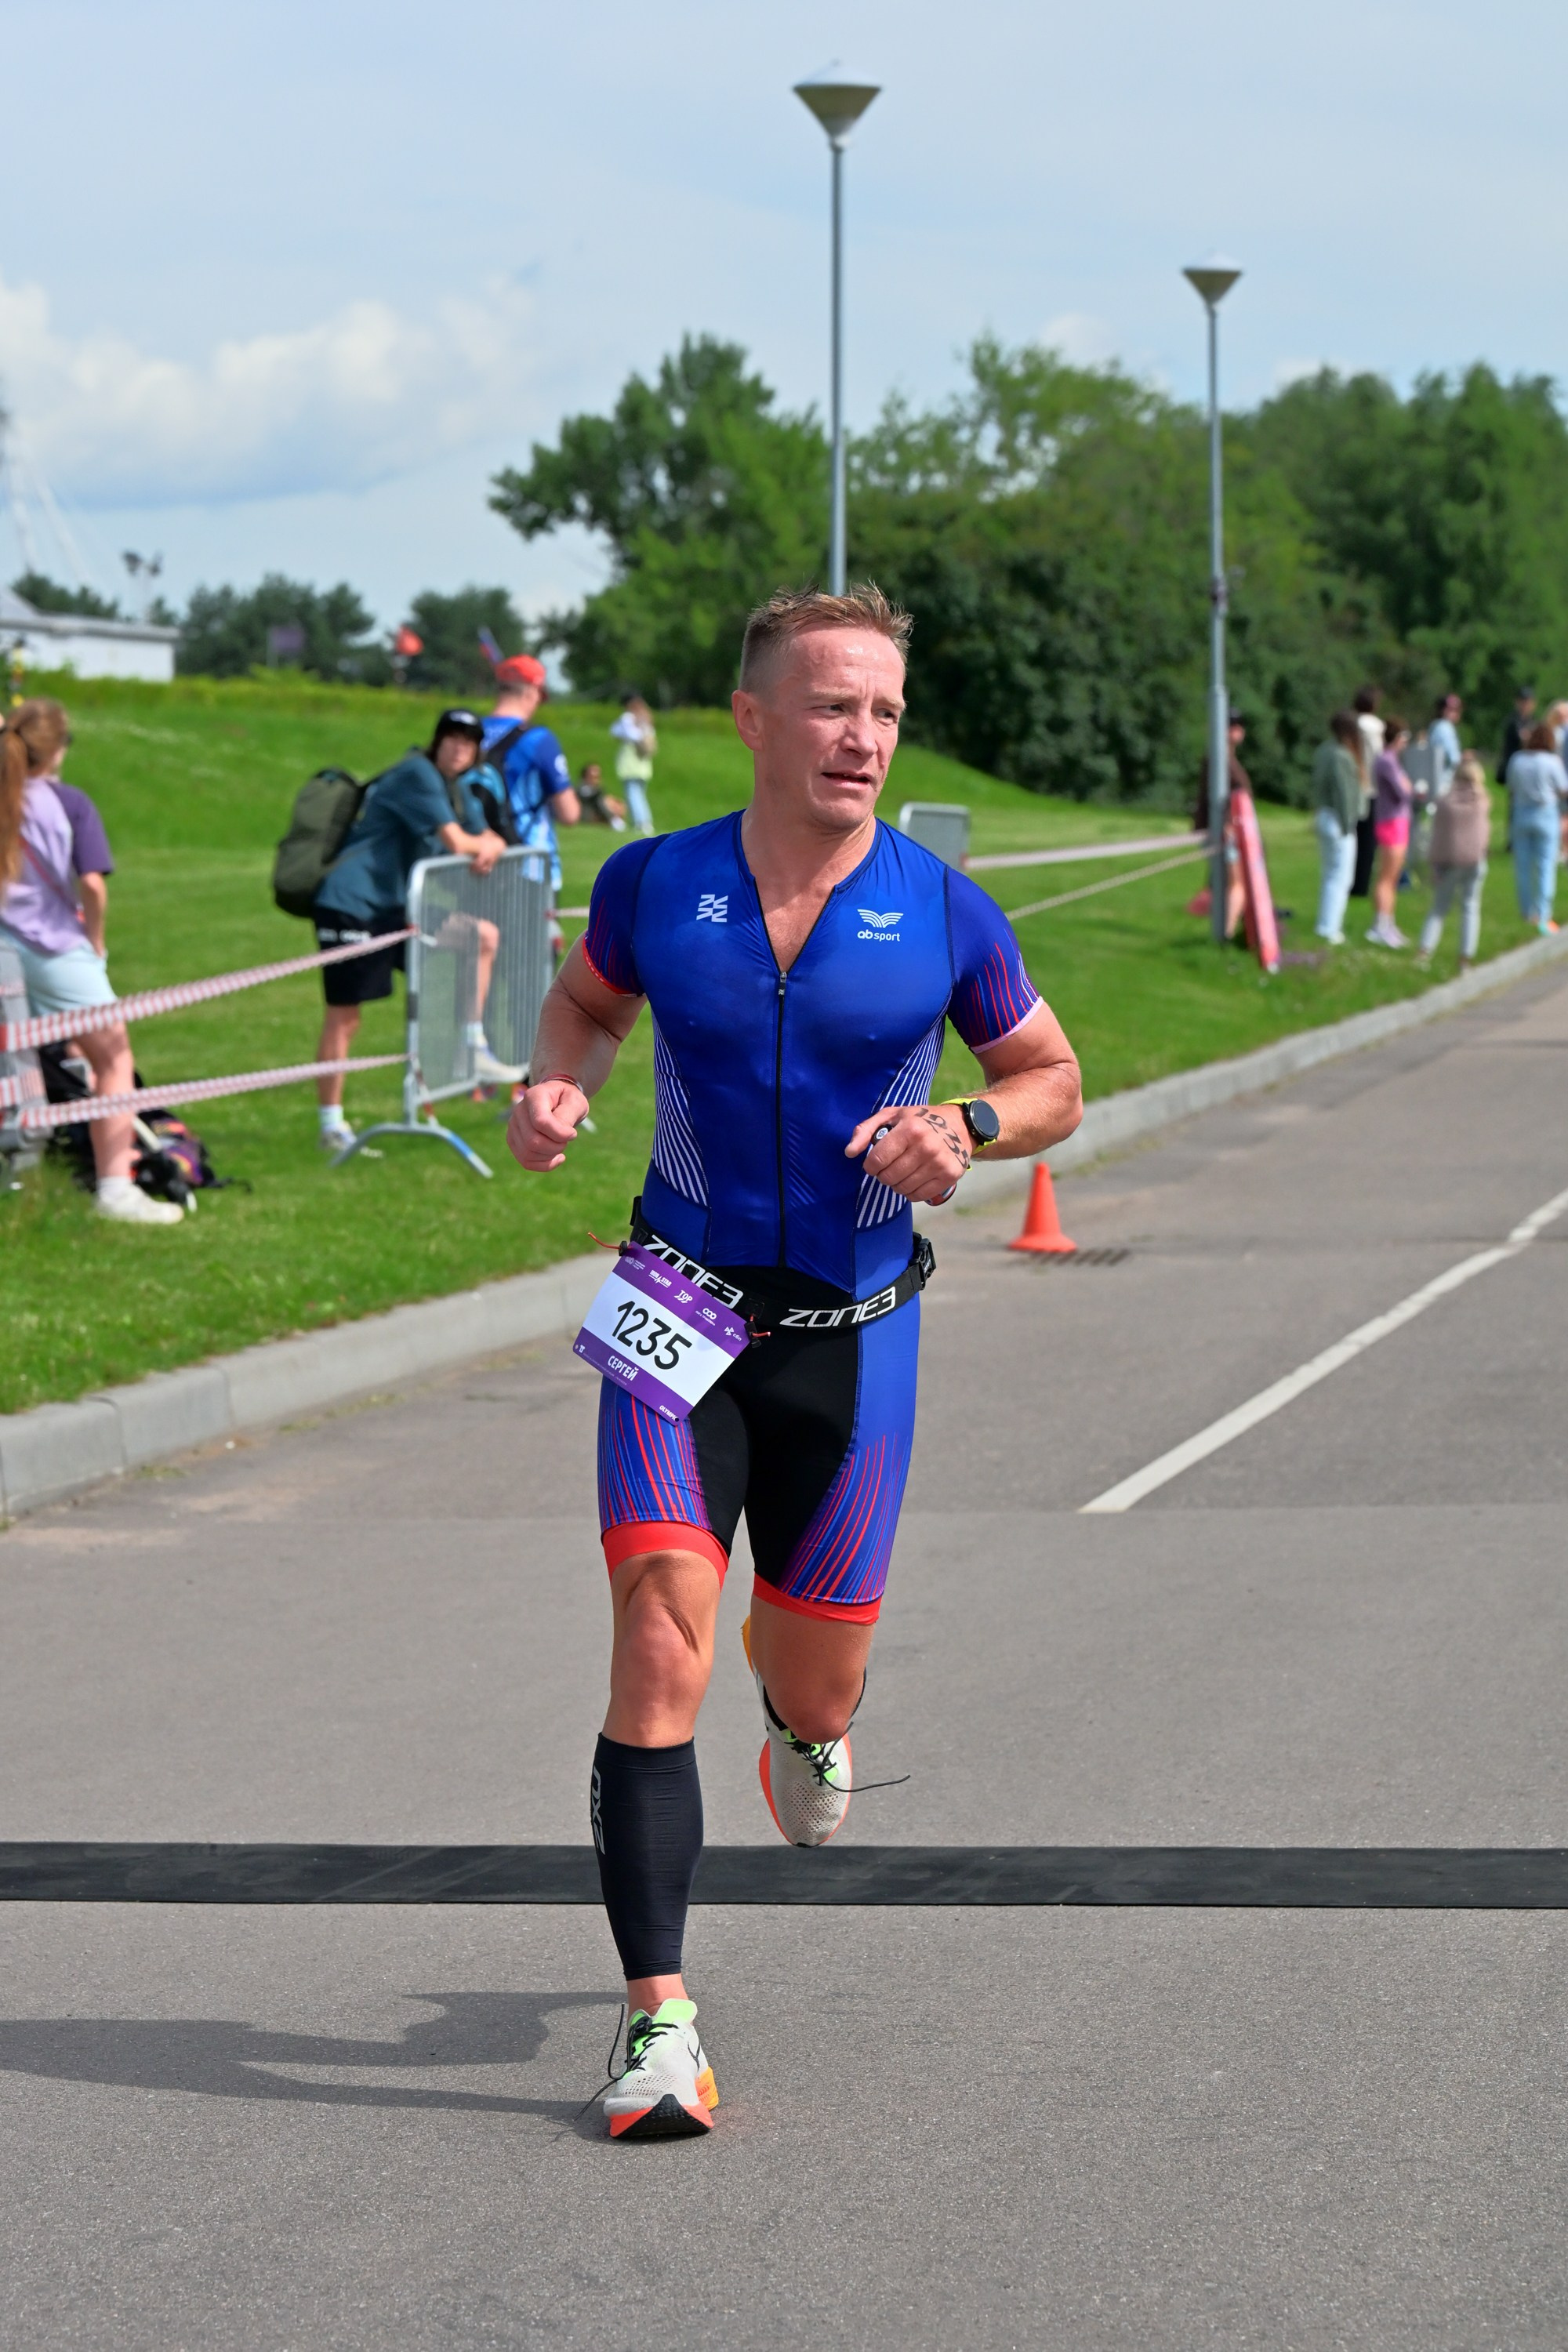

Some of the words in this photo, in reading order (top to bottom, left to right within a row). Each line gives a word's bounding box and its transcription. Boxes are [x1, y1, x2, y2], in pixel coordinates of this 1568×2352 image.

[679, 1290, 693, 1301] TOP
[779, 1286, 895, 1327] ZONE3
[612, 1301, 692, 1370] 1235
[607, 1355, 639, 1381] СЕРГЕЙ
